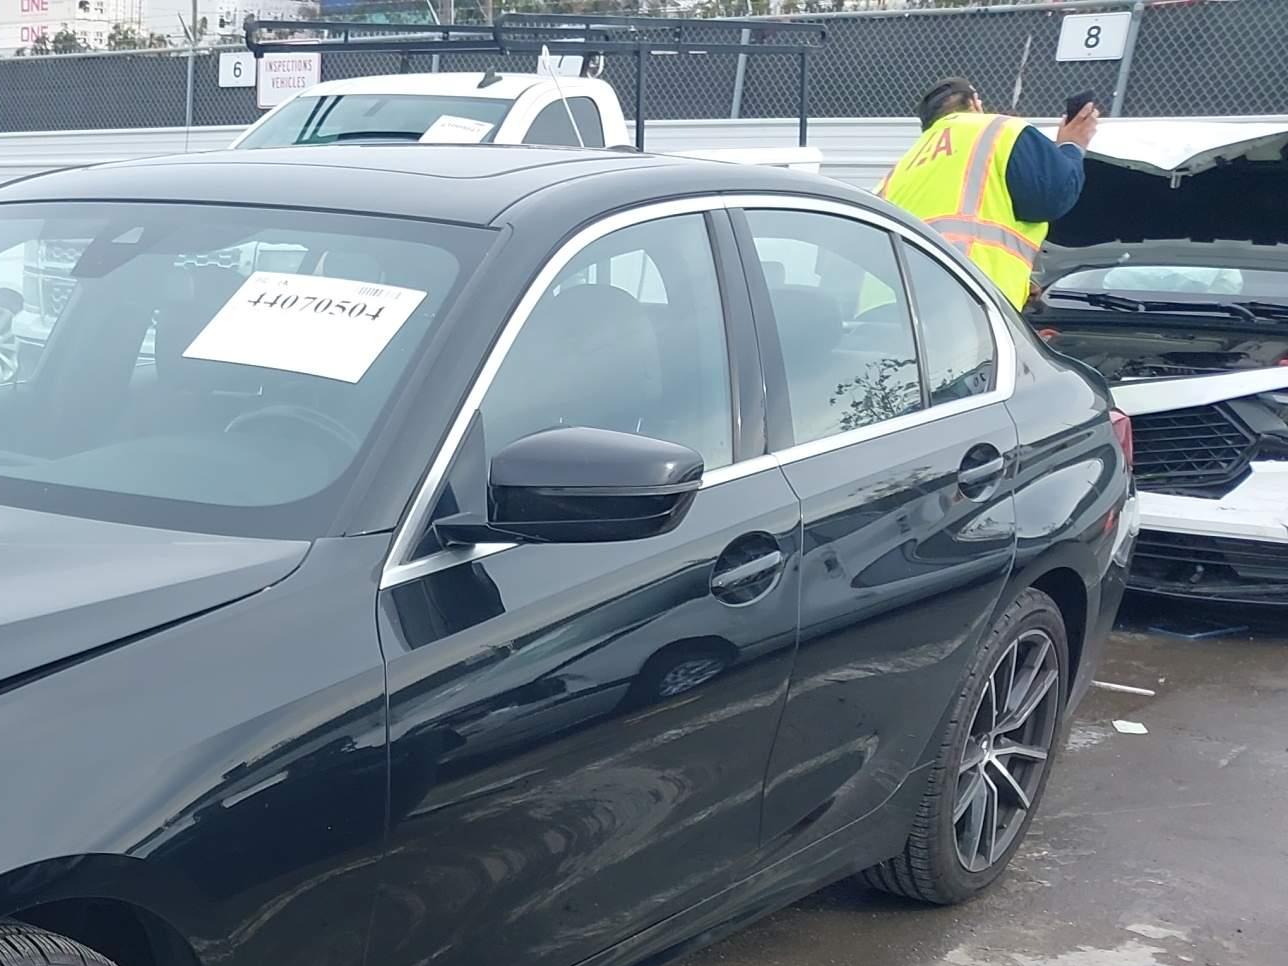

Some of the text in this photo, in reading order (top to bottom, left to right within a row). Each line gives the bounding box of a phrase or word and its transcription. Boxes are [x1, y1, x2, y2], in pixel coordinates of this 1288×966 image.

[21, 0, 49, 12] ONE
[1084, 25, 1101, 48] 8
[233, 61, 242, 78] 6
[265, 59, 313, 72] INSPECTIONS
[271, 76, 306, 89] VEHICLES
[248, 292, 386, 321] 44070504
